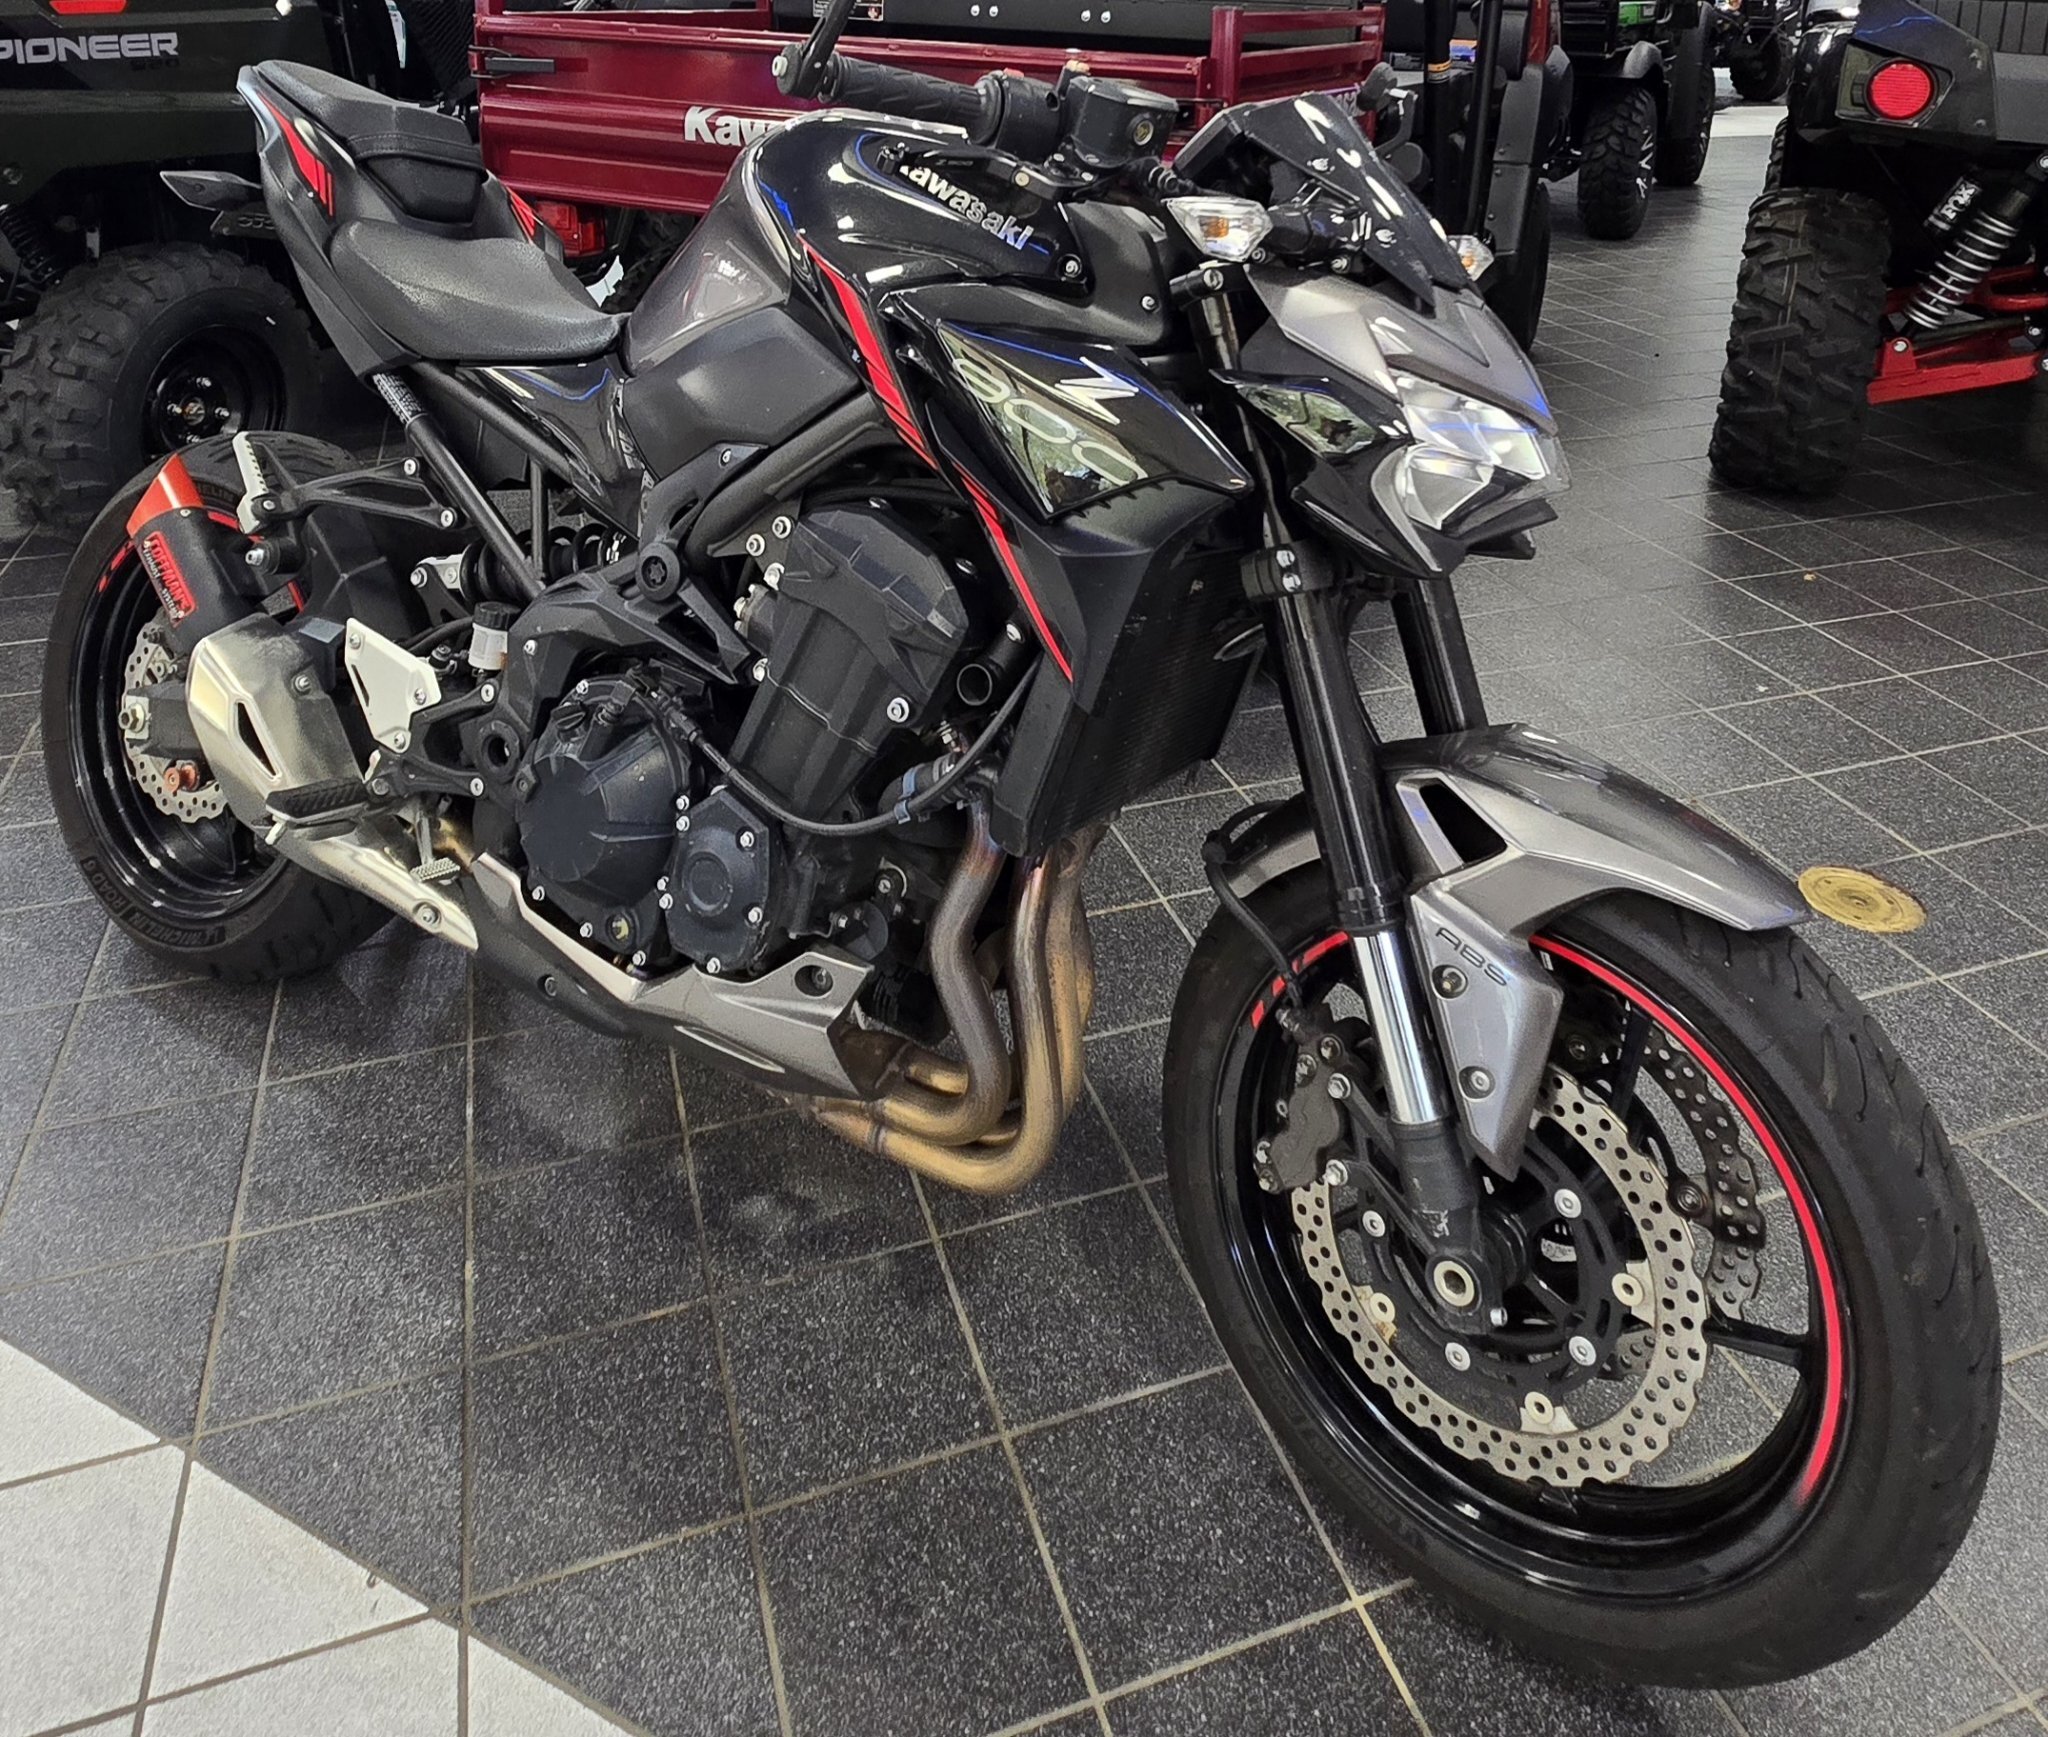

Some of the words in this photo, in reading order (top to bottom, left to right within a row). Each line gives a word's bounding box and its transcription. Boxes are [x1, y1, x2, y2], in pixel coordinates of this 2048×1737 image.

[0, 32, 179, 64] PIONEER
[684, 105, 784, 147] Kaw
[1940, 182, 1977, 220] FOX
[1435, 927, 1507, 986] ABS
